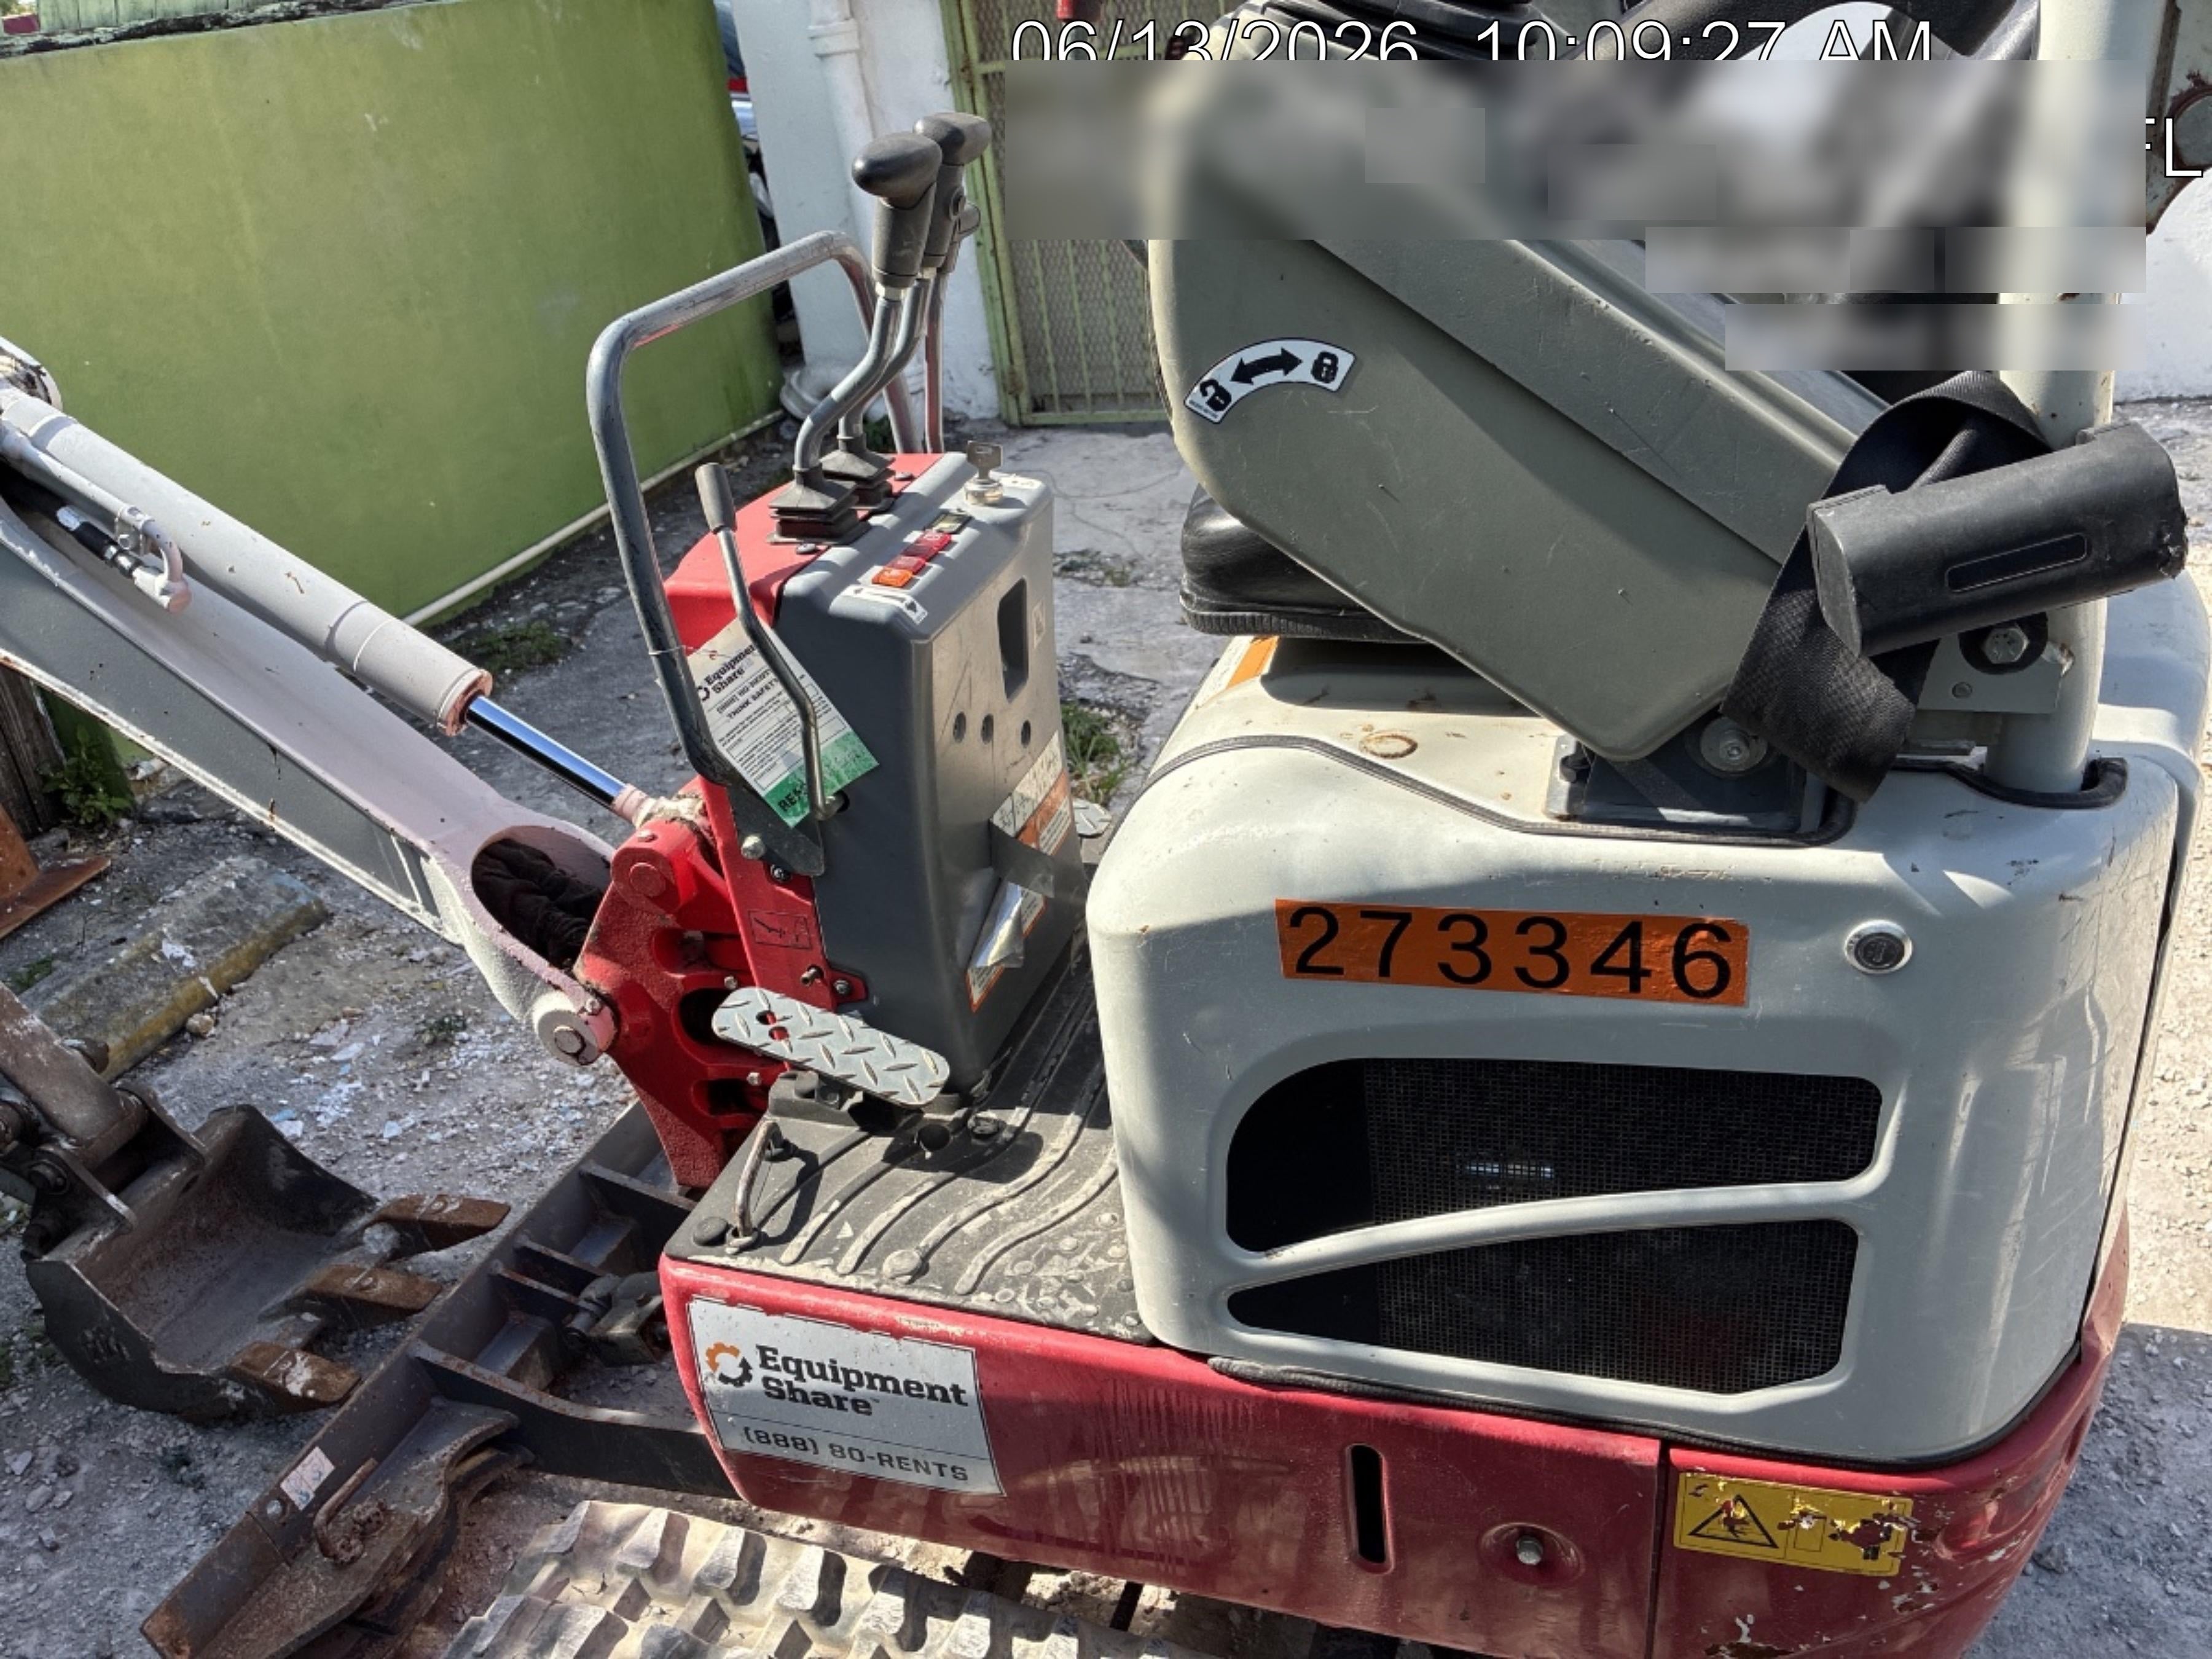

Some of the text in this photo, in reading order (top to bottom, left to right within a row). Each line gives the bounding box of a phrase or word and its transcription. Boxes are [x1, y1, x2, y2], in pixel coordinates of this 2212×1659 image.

[1288, 906, 1732, 999] 273346
[756, 1344, 969, 1406] Equipment
[743, 1426, 969, 1481] (888) 80-RENTS
